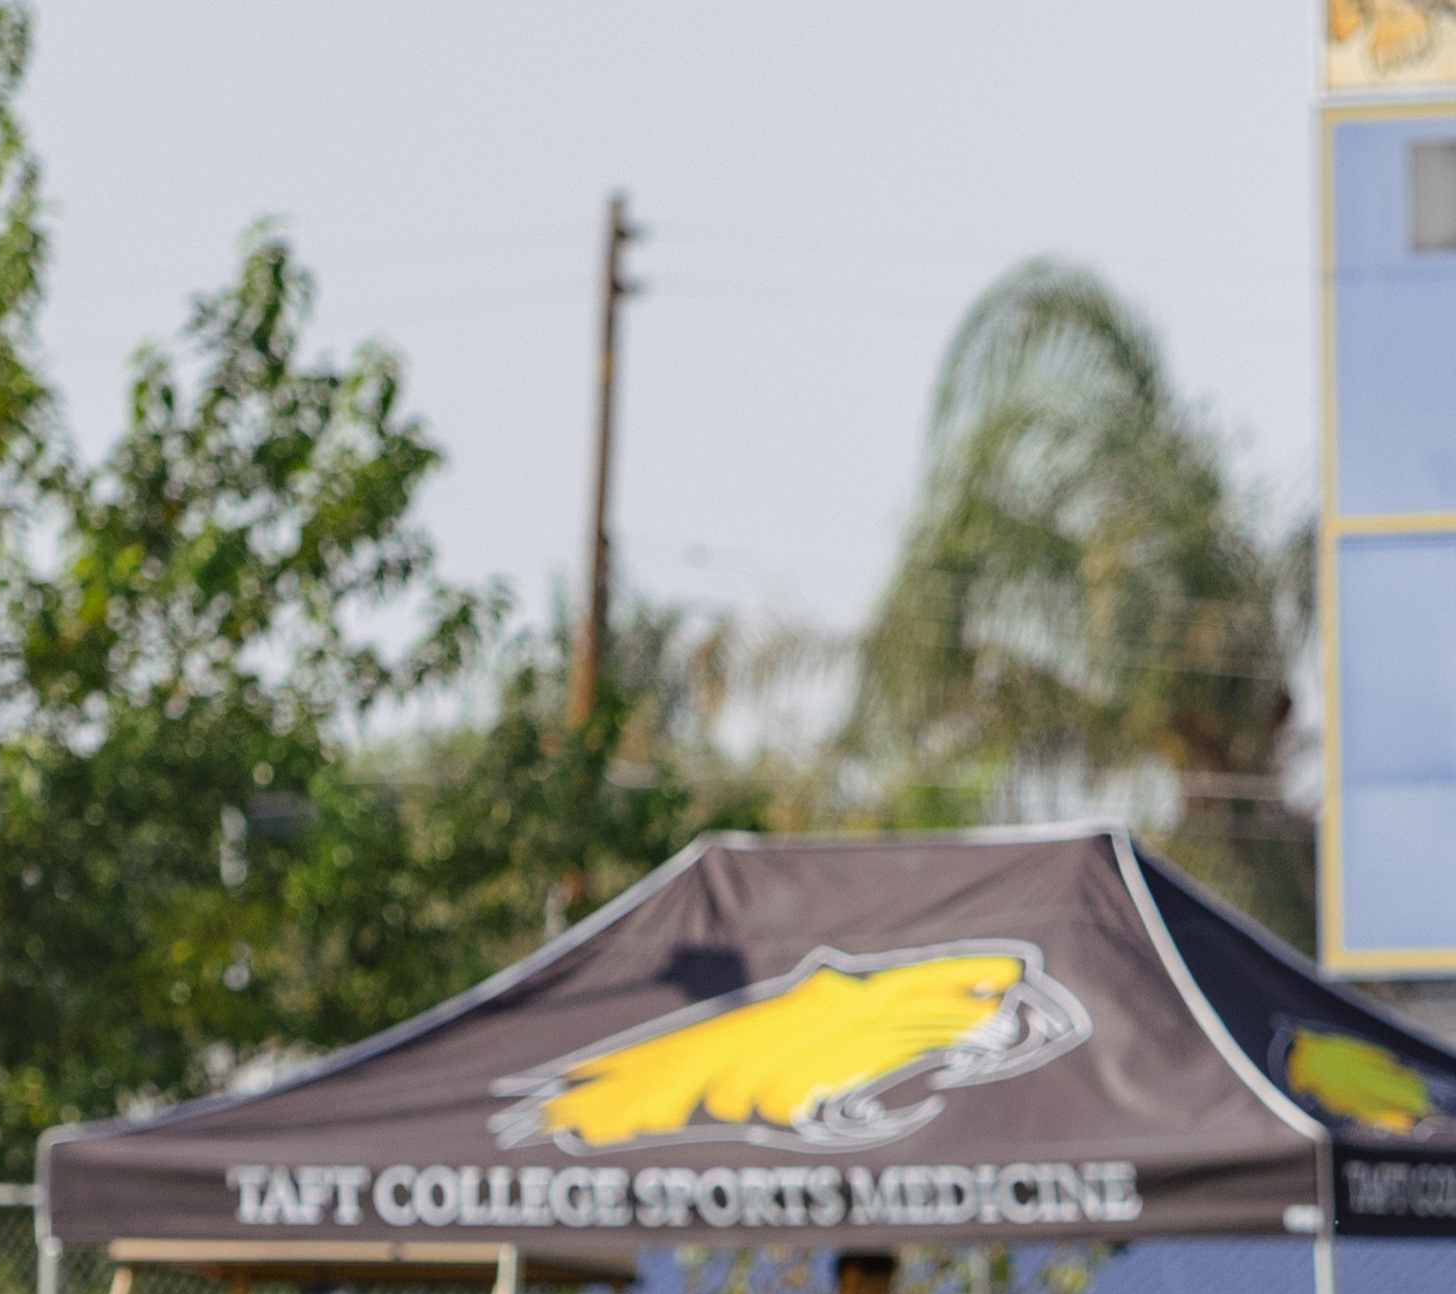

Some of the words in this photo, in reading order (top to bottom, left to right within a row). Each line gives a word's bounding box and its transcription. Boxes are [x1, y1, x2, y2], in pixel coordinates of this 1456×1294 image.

[228, 1166, 370, 1225] TAFT
[373, 1165, 631, 1227] COLLEGE
[634, 1165, 846, 1226] SPORTS
[848, 1160, 1142, 1224] MEDICINE
